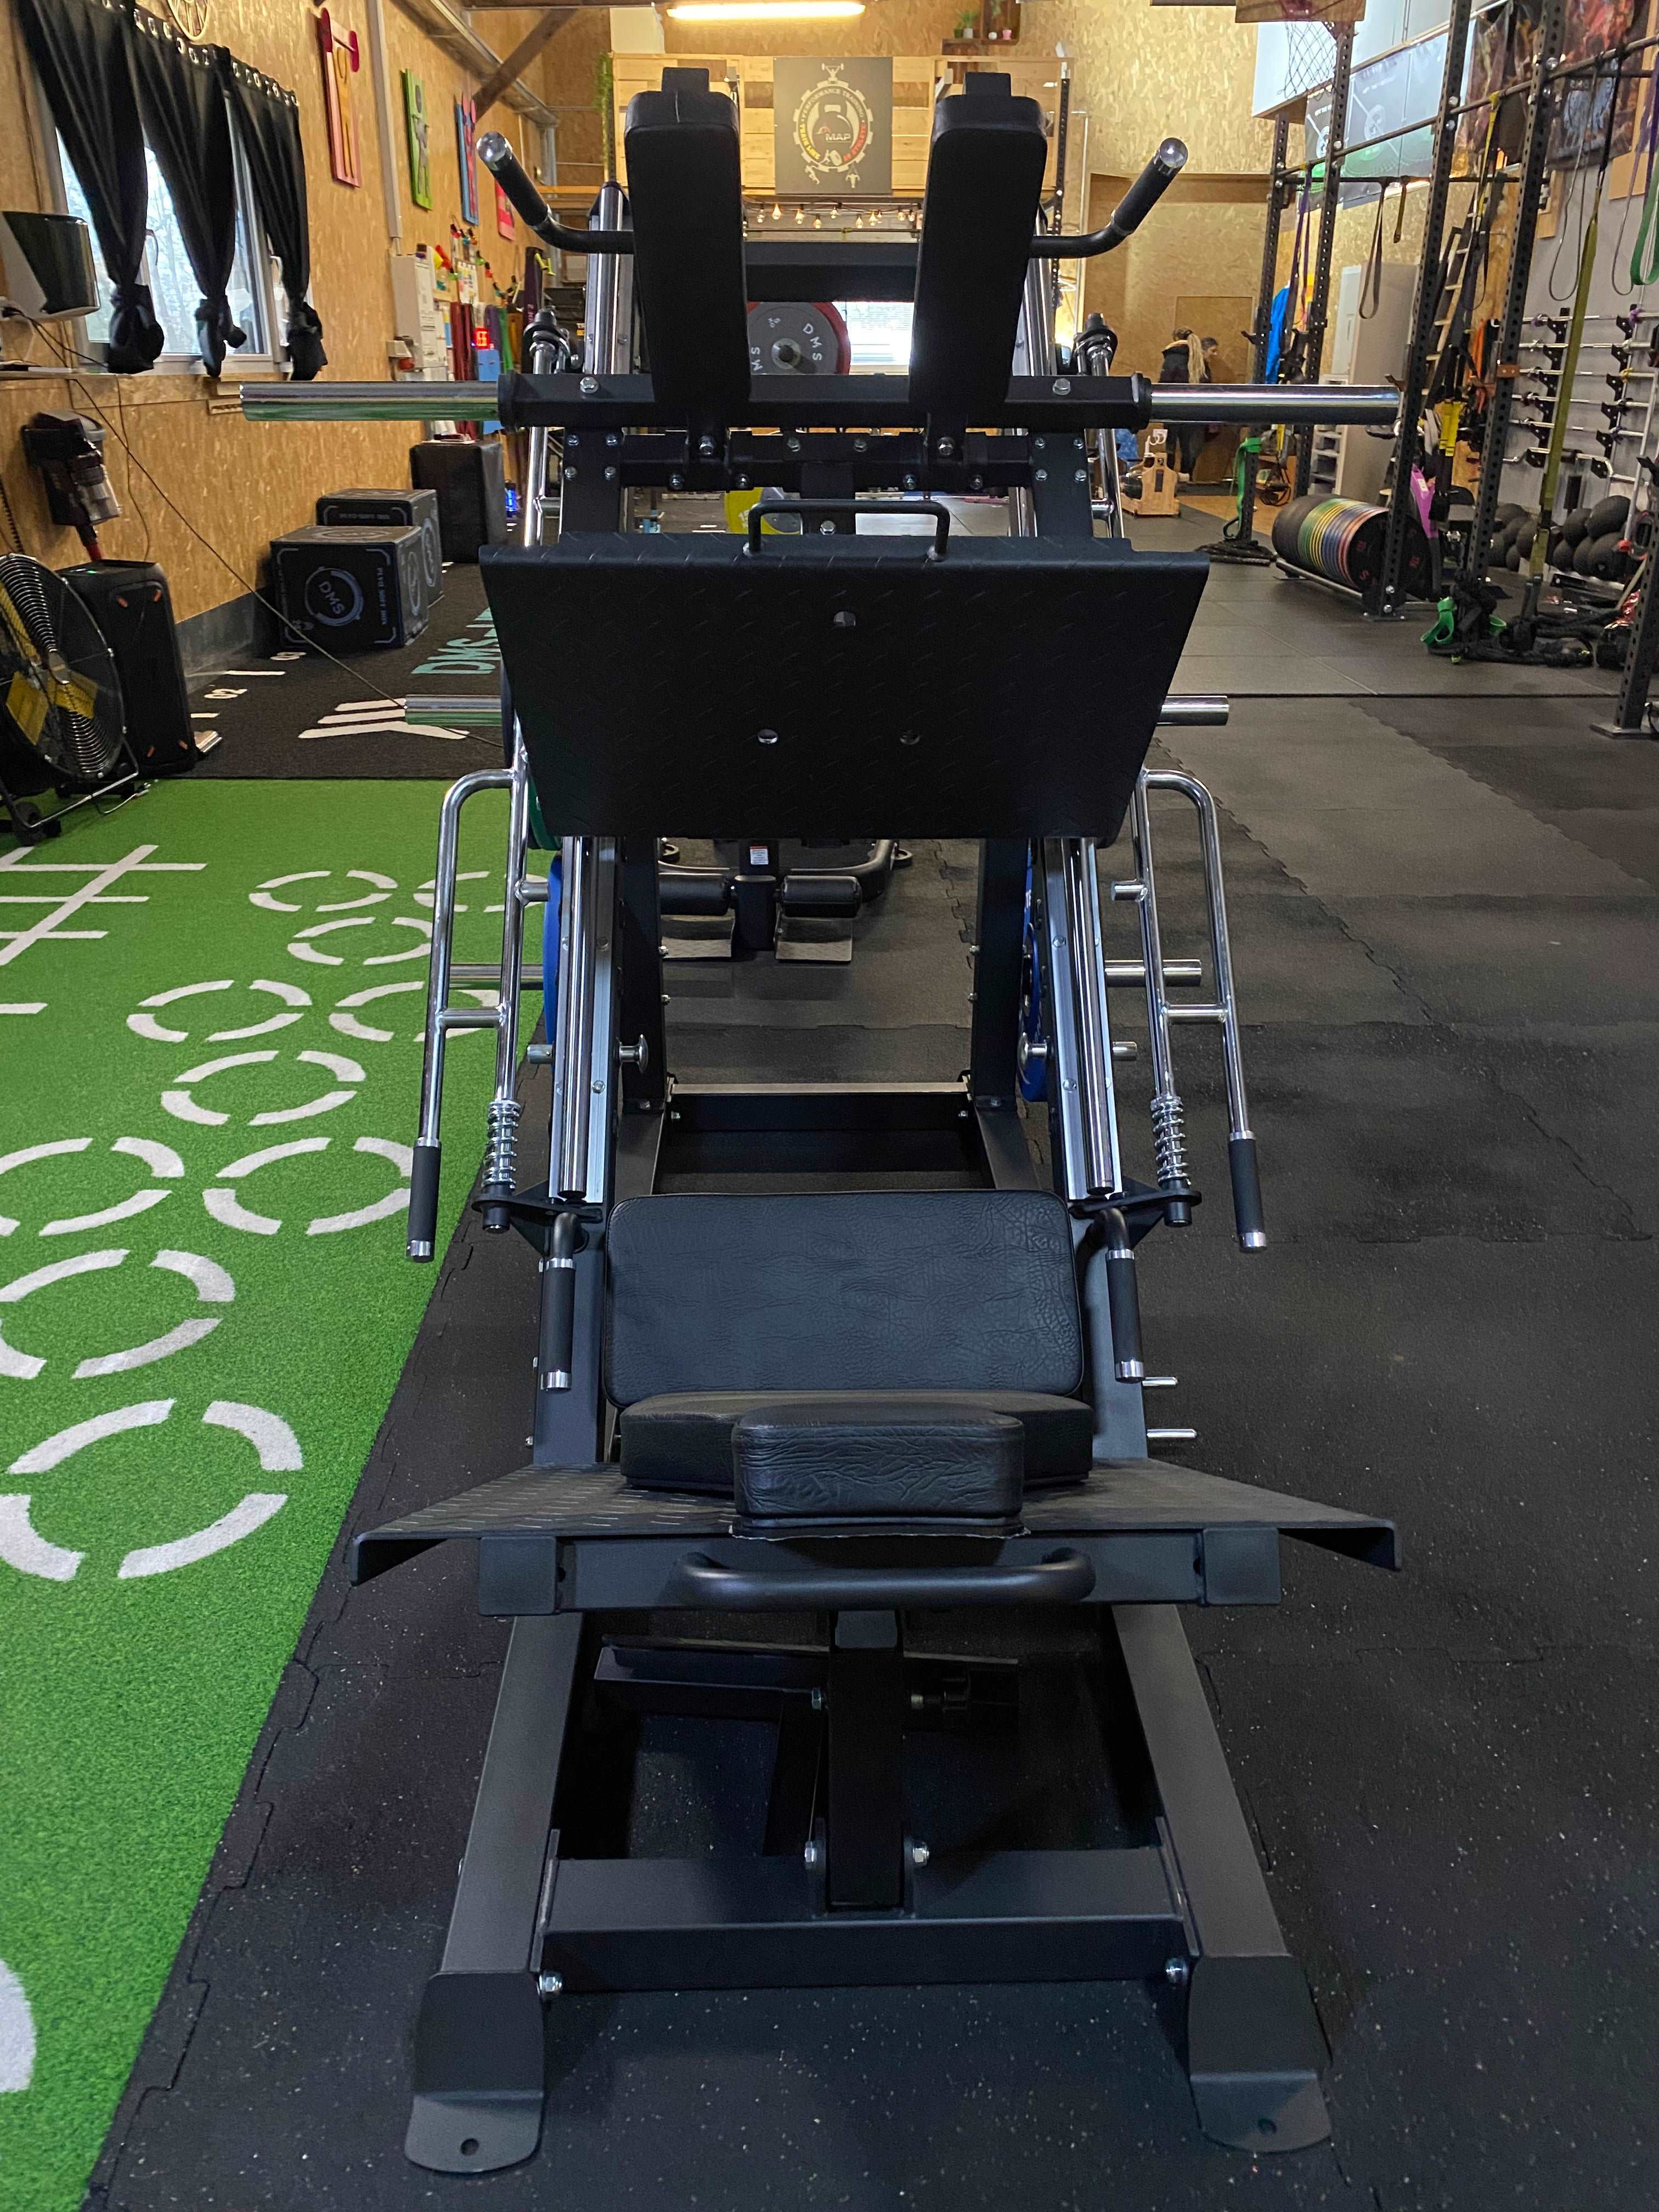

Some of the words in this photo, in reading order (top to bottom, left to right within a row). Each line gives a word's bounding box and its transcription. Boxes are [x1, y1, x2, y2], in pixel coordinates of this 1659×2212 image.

[825, 133, 851, 141] MAP
[803, 323, 822, 361] DMS
[318, 580, 345, 614] DMS
[204, 689, 247, 699] 02
